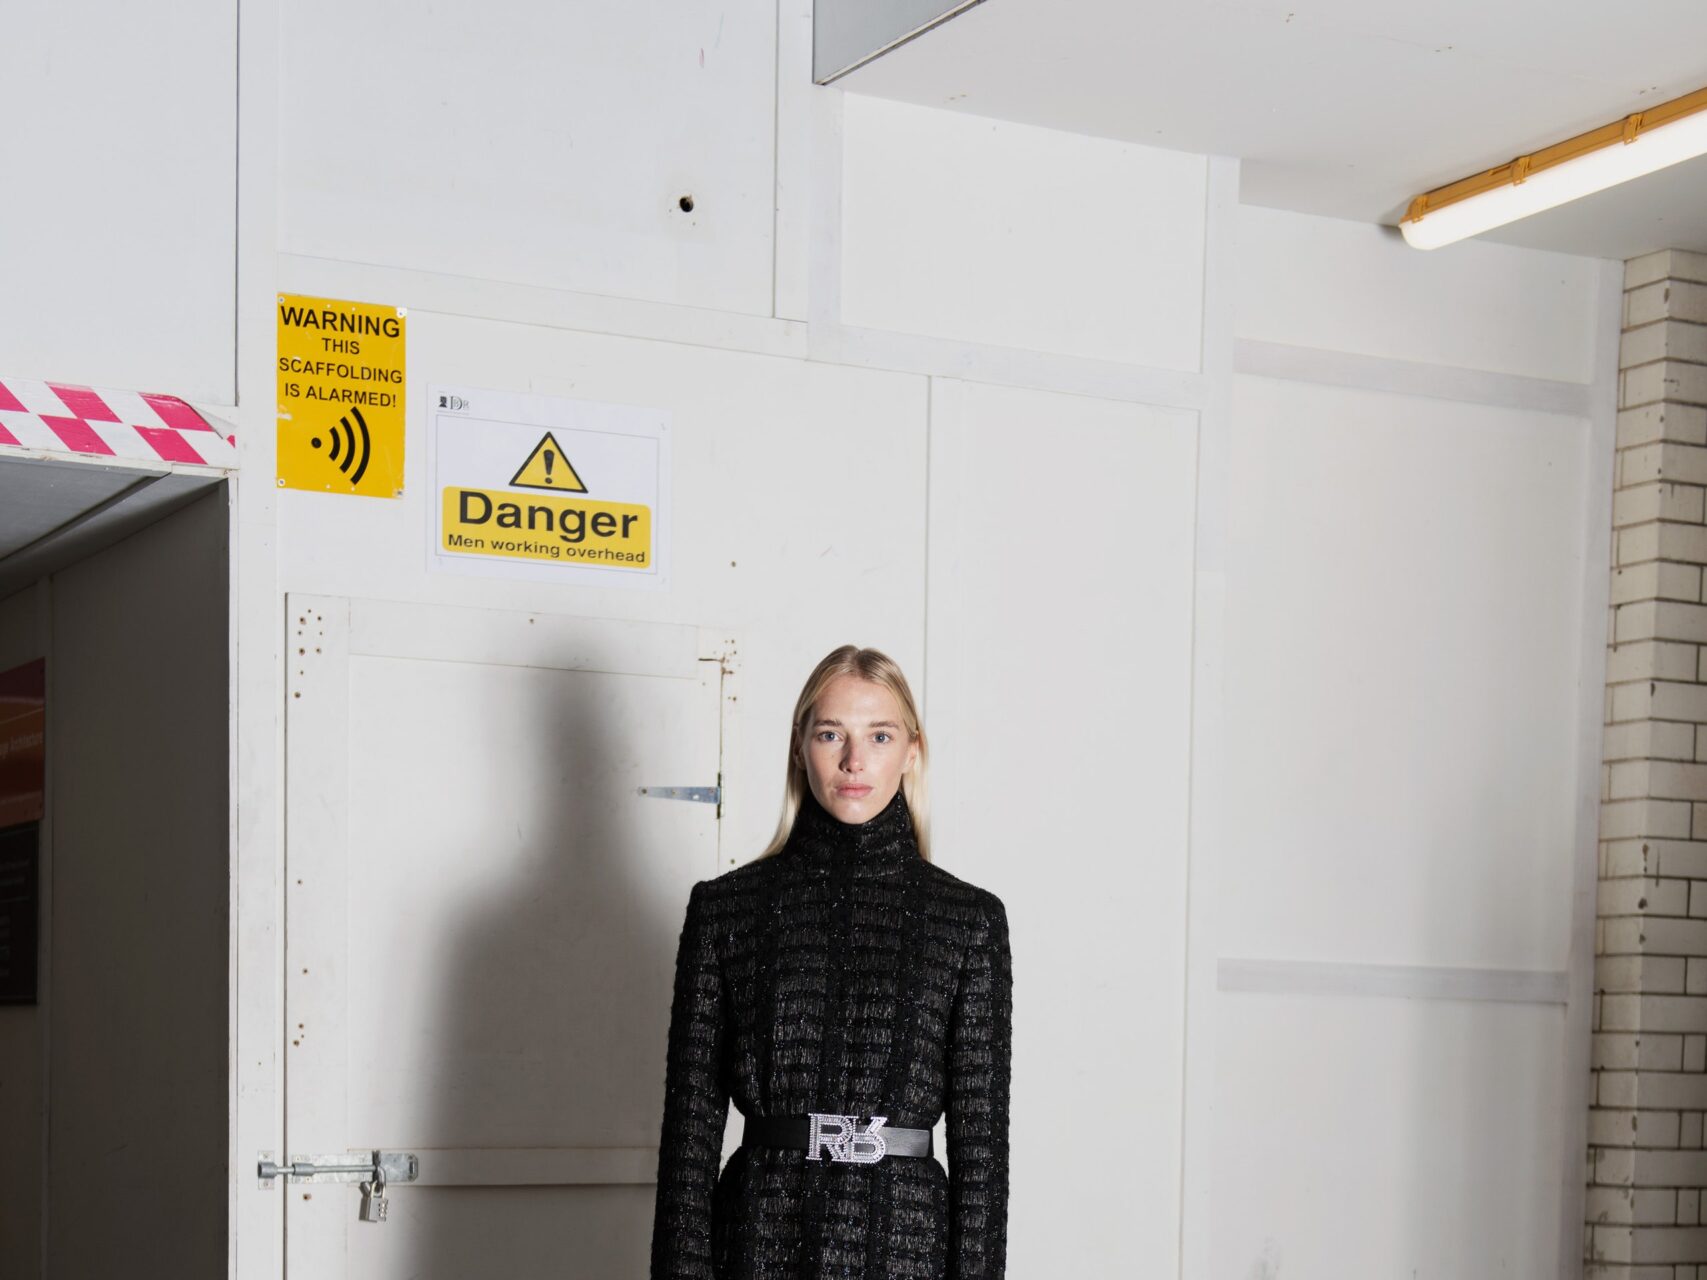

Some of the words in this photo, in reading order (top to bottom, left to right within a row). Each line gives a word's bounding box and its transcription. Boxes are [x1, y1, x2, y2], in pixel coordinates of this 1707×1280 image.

[280, 305, 400, 338] WARNING
[321, 337, 360, 355] THIS
[279, 357, 403, 384] SCAFFOLDING
[285, 382, 300, 398] IS
[305, 385, 396, 408] ALARMED!
[459, 490, 638, 543] Danger
[448, 534, 485, 549] Men
[490, 539, 560, 559] working
[566, 546, 646, 564] overhead
